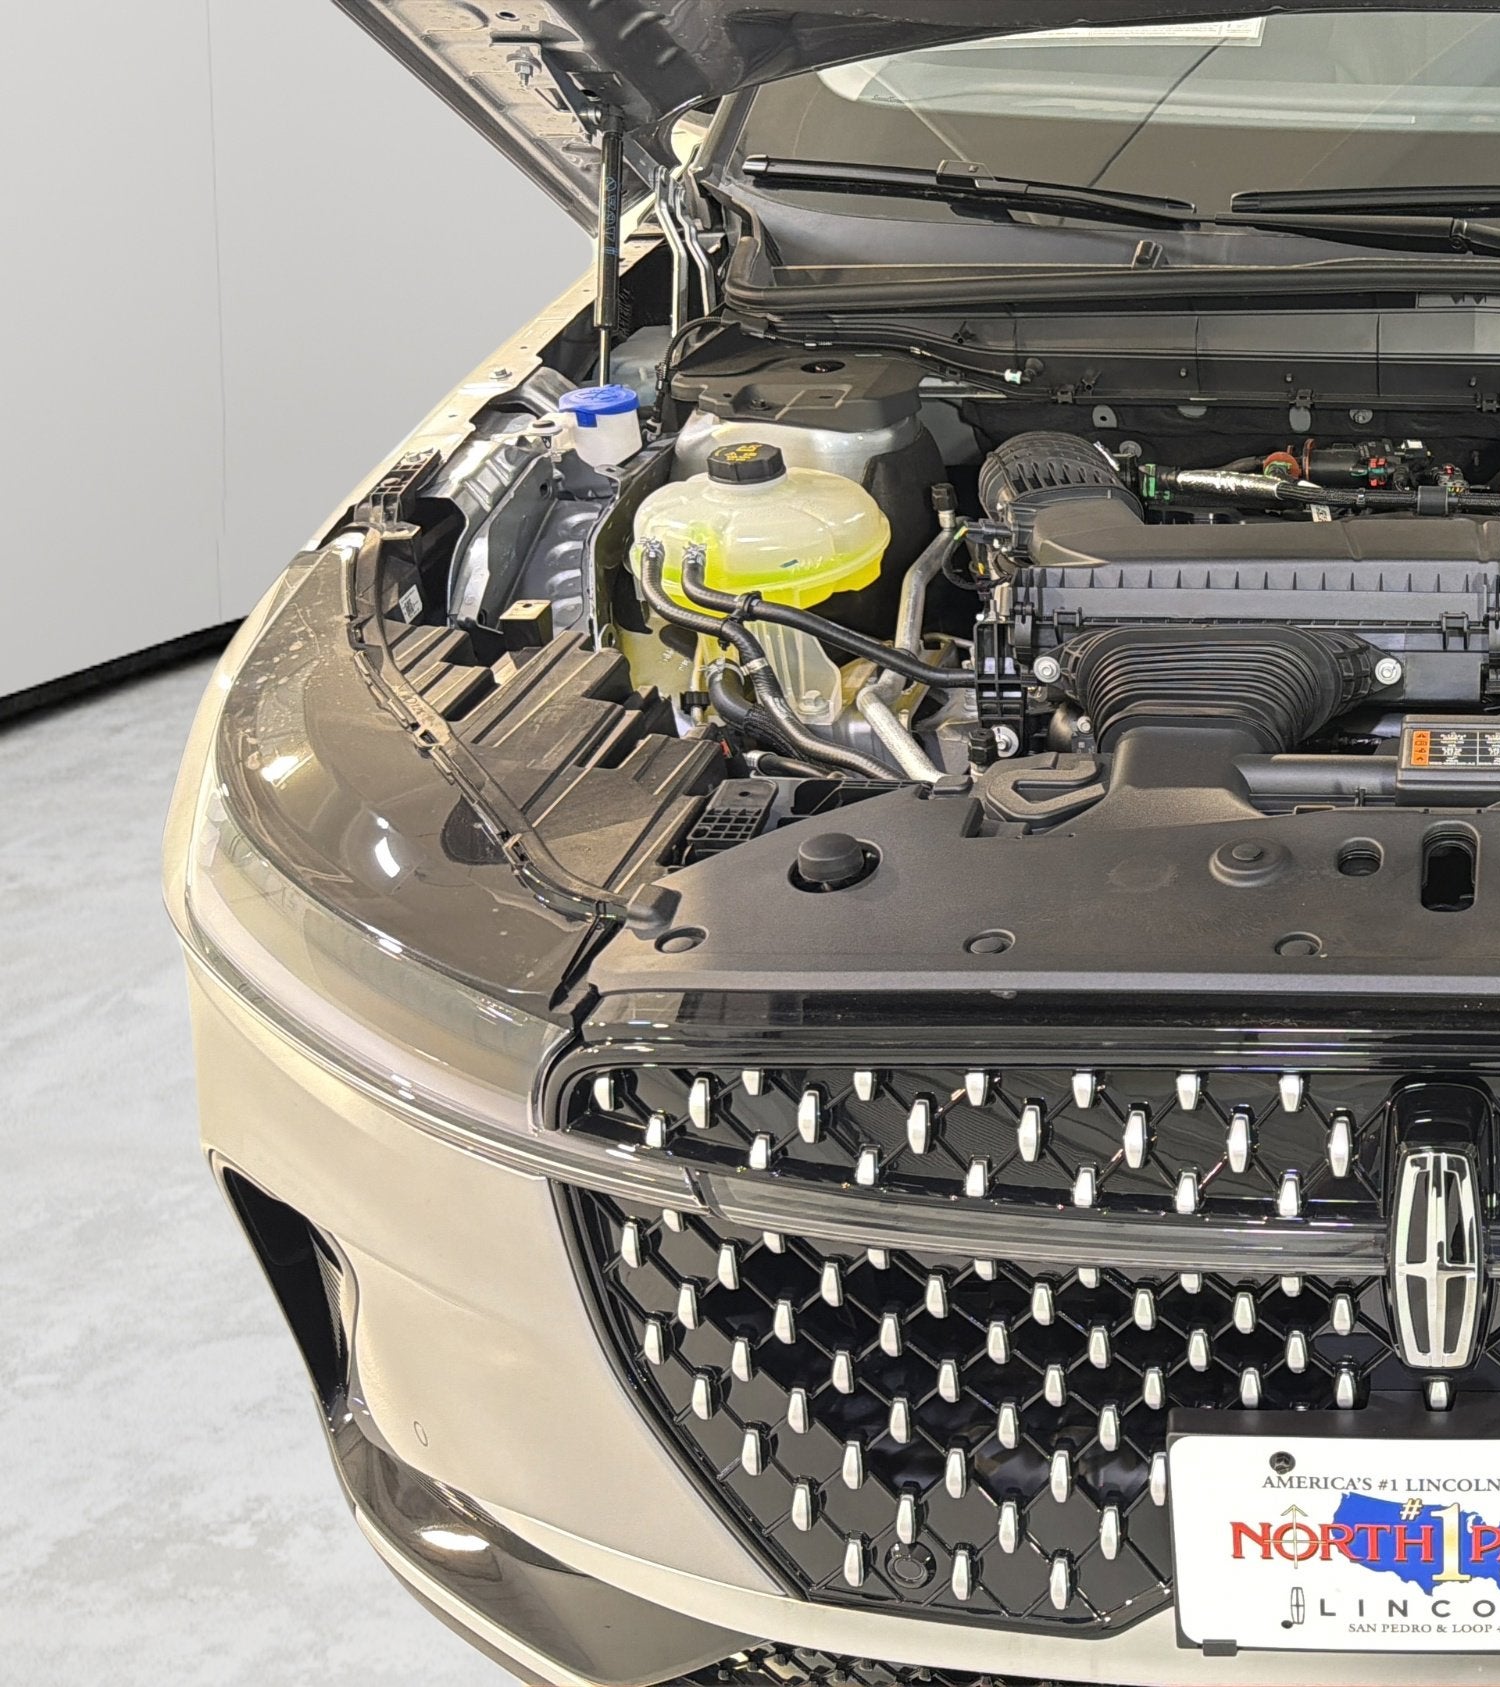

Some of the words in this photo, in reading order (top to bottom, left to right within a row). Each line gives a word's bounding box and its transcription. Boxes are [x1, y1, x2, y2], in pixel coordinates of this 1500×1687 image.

[1262, 1475, 1372, 1491] AMERICA'S
[1378, 1479, 1398, 1492] #1
[1229, 1521, 1434, 1563] NORTH
[1348, 1623, 1377, 1633] SAN
[1381, 1623, 1432, 1633] PEDRO
[1436, 1624, 1447, 1633] &
[1452, 1624, 1493, 1633] LOOP
